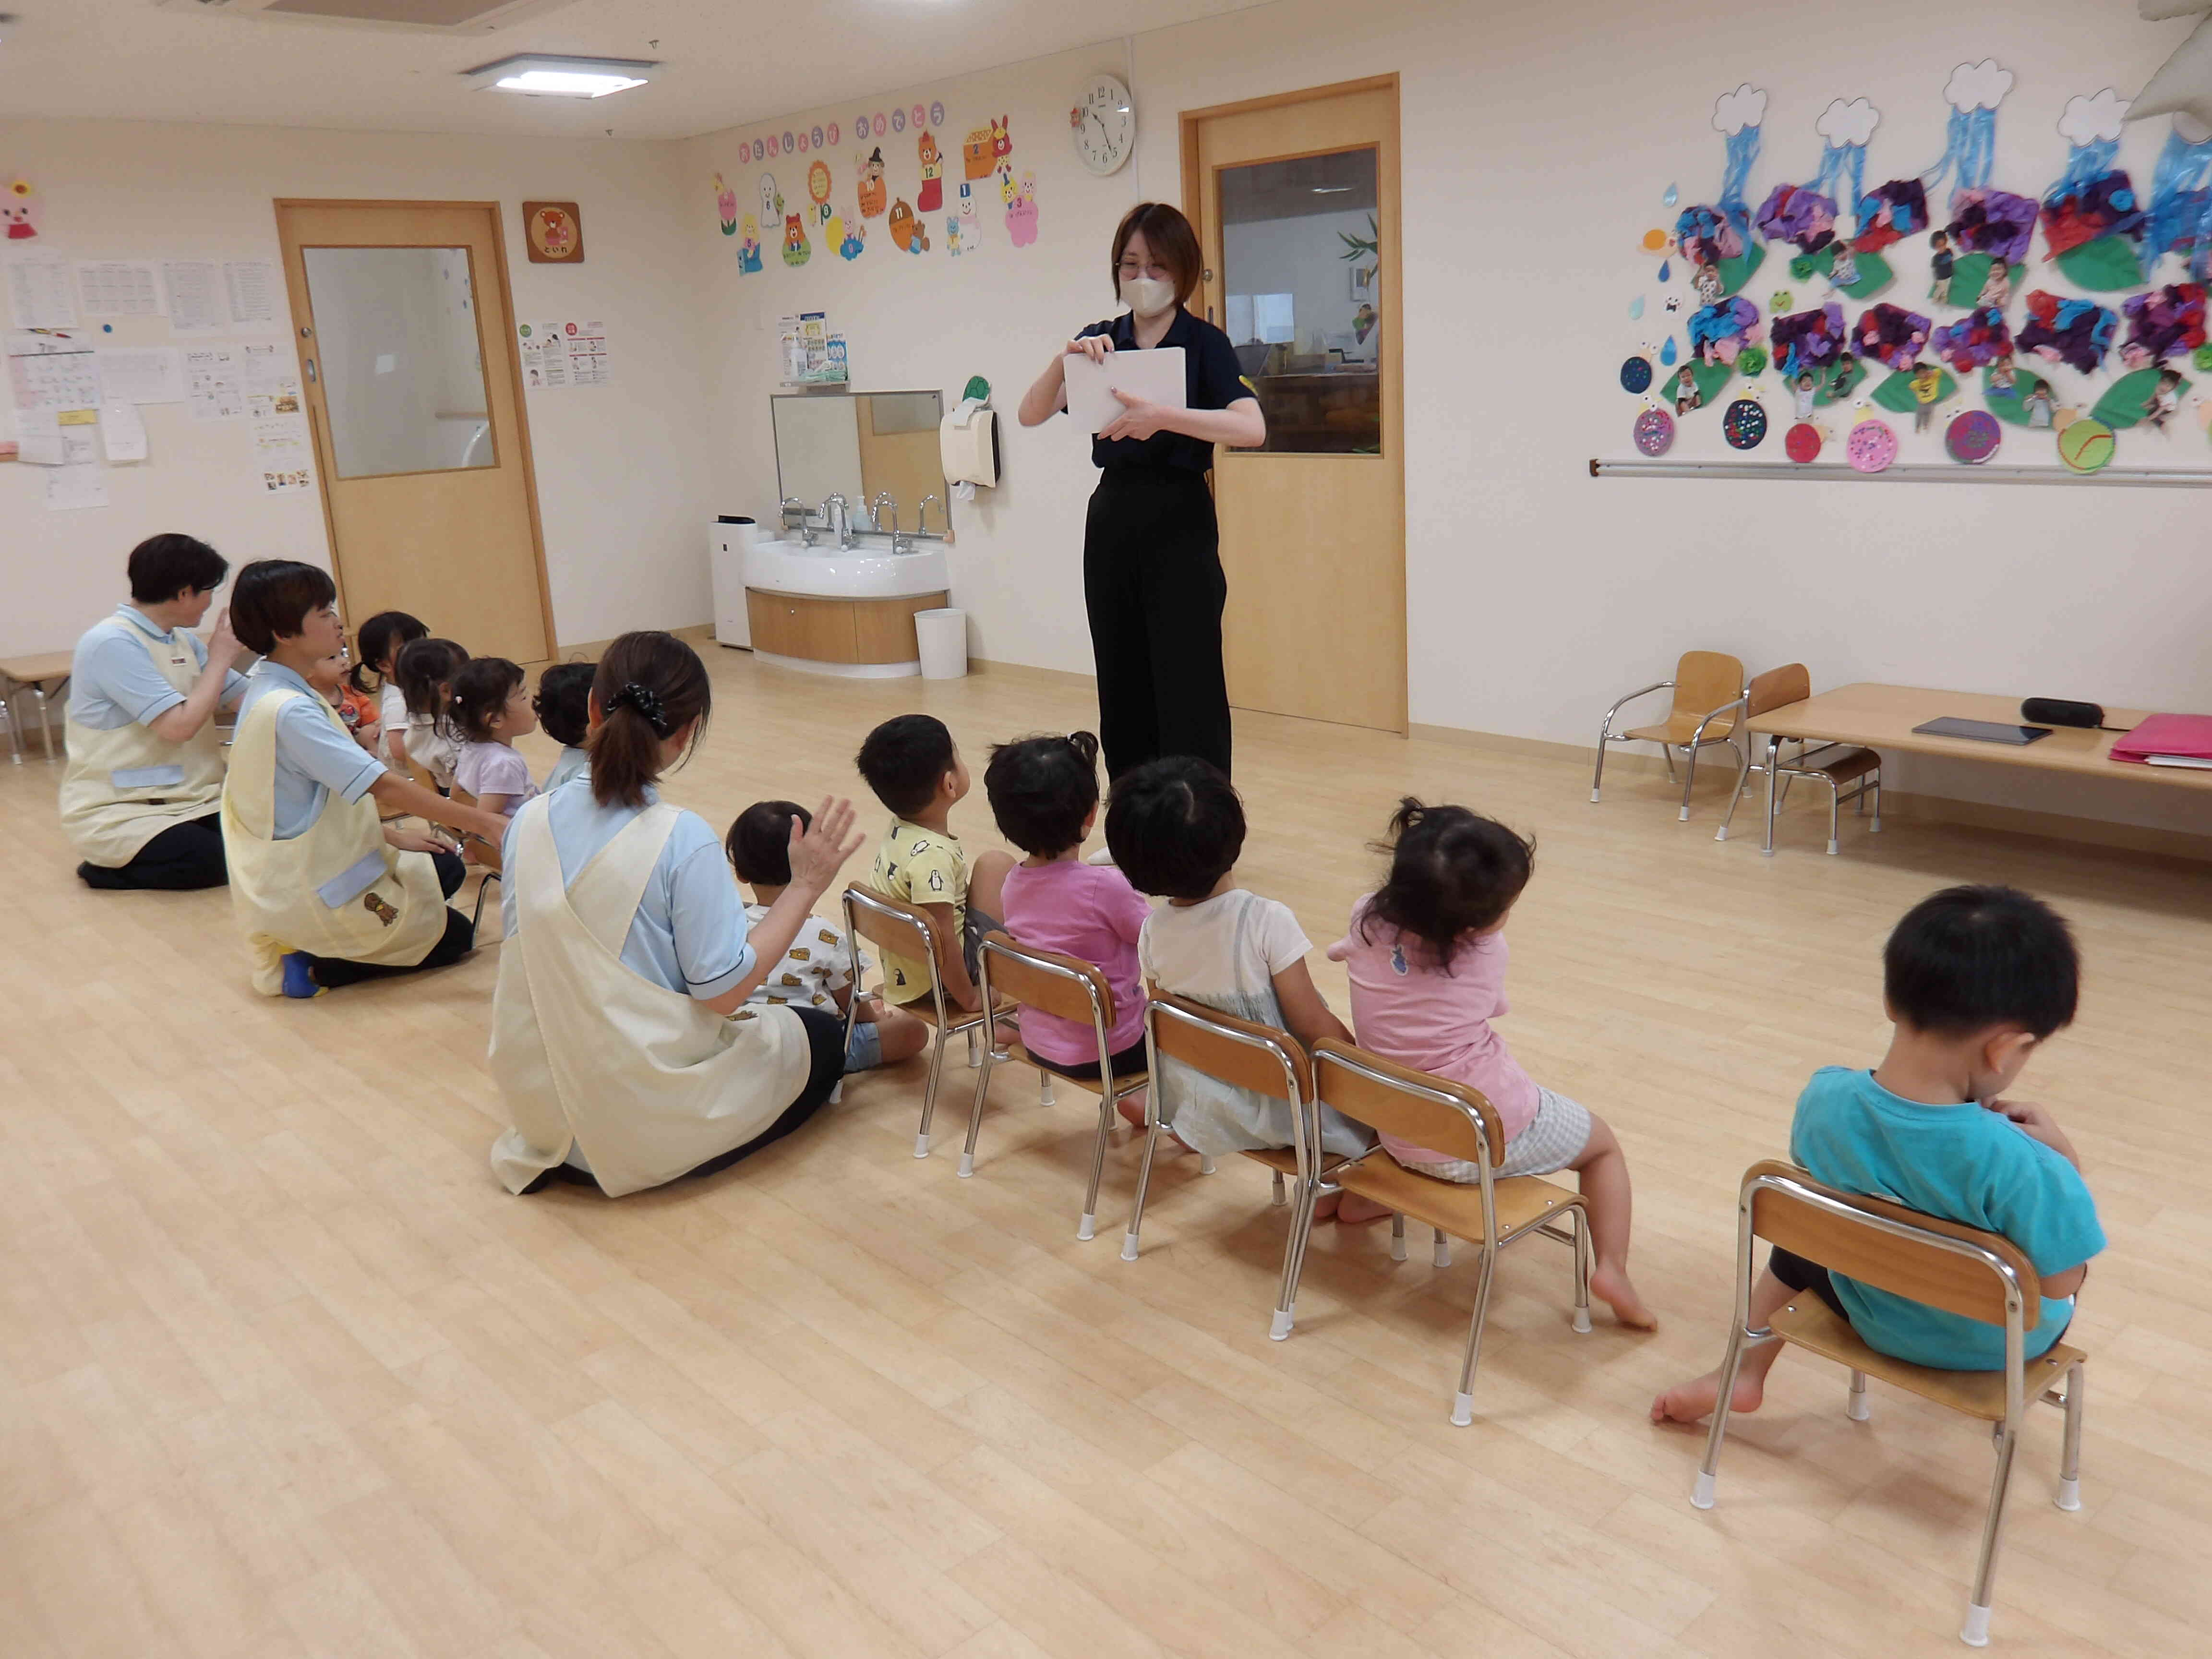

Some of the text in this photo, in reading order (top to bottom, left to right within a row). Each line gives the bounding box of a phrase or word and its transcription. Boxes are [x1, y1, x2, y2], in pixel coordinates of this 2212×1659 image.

[1098, 86, 1105, 98] 12
[1088, 93, 1094, 104] 11
[1082, 107, 1089, 118] 10
[1121, 115, 1126, 127] 3
[740, 105, 942, 162] おたんじょうび おめでとう
[1080, 123, 1085, 134] 9
[1118, 132, 1123, 143] 4
[973, 144, 979, 154] 2
[1084, 139, 1089, 150] 8
[1092, 150, 1097, 161] 7
[1103, 152, 1107, 163] 6
[1113, 147, 1118, 158] 5
[925, 167, 934, 179] 12
[866, 179, 875, 192] 10
[962, 185, 967, 196] 1
[766, 201, 770, 210] 6
[1017, 197, 1022, 207] 3
[824, 205, 829, 215] 8
[895, 207, 903, 219] 11
[747, 239, 752, 247] 5
[793, 242, 798, 252] 7
